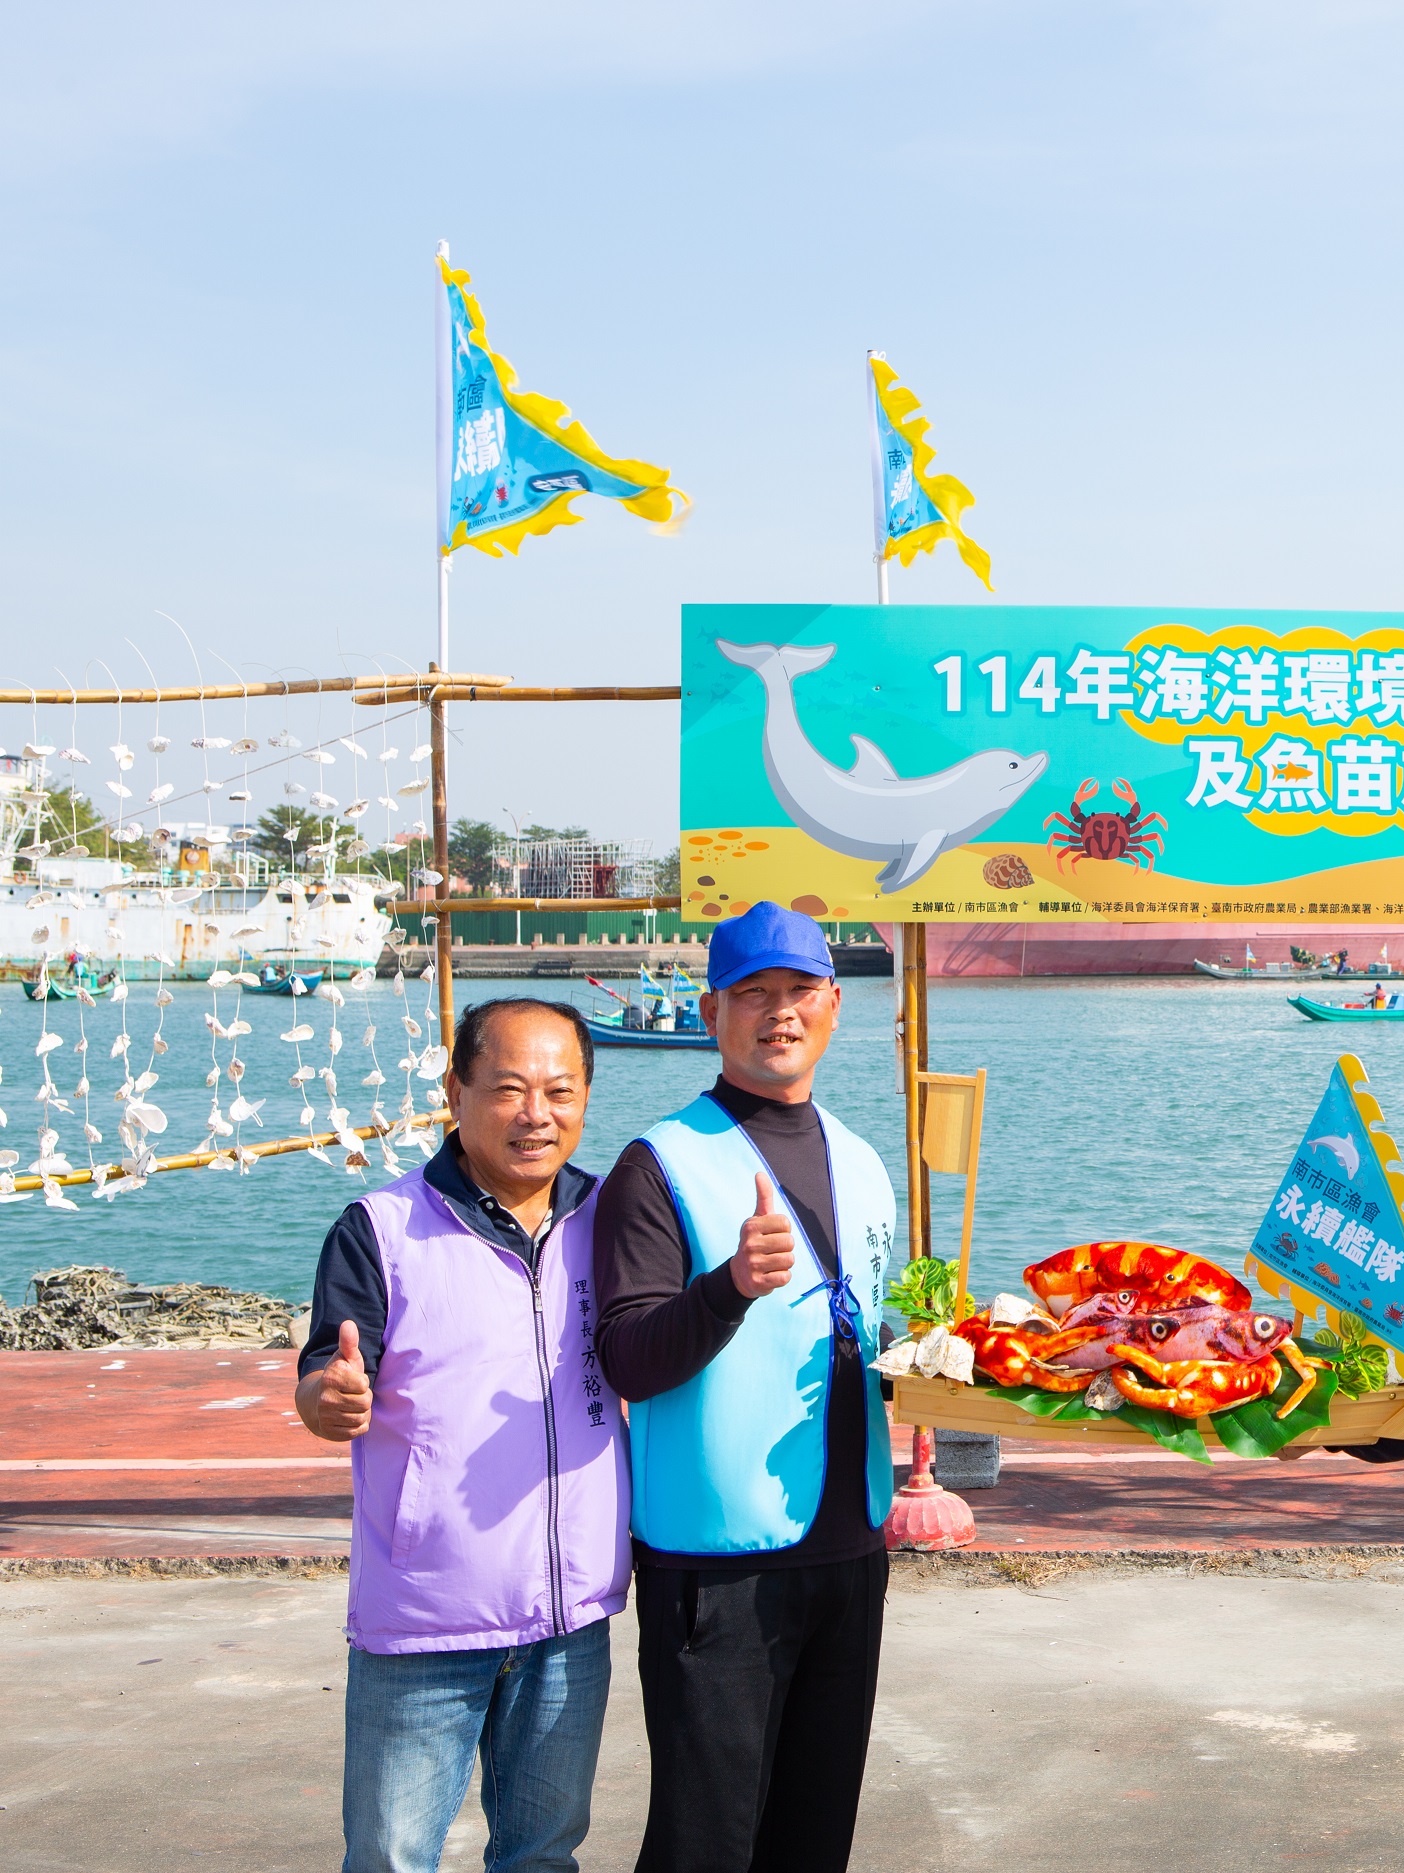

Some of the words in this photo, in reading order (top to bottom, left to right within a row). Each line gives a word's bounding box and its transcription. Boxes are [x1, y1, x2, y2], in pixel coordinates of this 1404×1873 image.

[1291, 1158, 1381, 1224] 南市區漁會
